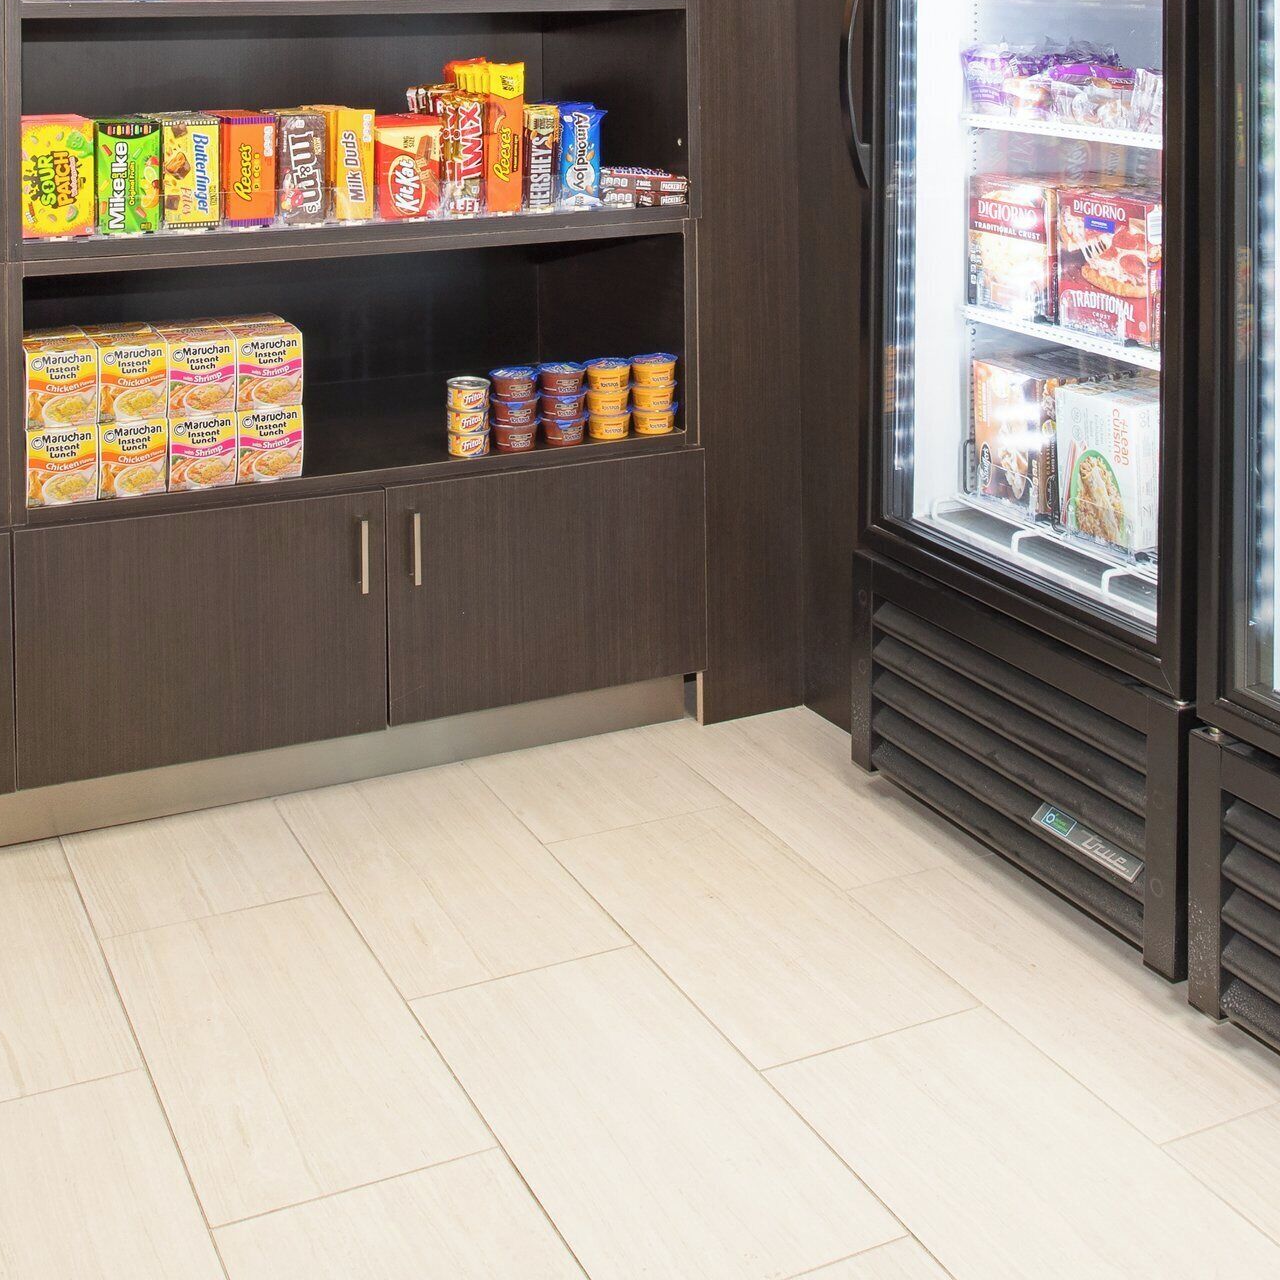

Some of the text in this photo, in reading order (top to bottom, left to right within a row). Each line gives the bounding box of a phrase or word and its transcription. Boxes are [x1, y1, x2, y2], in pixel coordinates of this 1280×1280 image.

[348, 131, 366, 204] Milk Duds
[455, 102, 482, 188] TWIX
[493, 127, 511, 183] Reese's
[38, 155, 56, 206] SOUR
[54, 151, 71, 207] PATCH
[192, 133, 210, 214] Butterfinger
[234, 143, 253, 201] Reese's
[529, 136, 552, 208] HERSHEY'S
[974, 221, 1040, 240] TRADITIONAL CRUST
[43, 353, 92, 365] Maruchan
[251, 339, 297, 350] Maruchan
[45, 382, 80, 392] Chicken
[46, 365, 80, 373] Instant
[50, 372, 76, 380] Lunch
[262, 364, 290, 376] Shrimp
[1081, 830, 1129, 873] True
